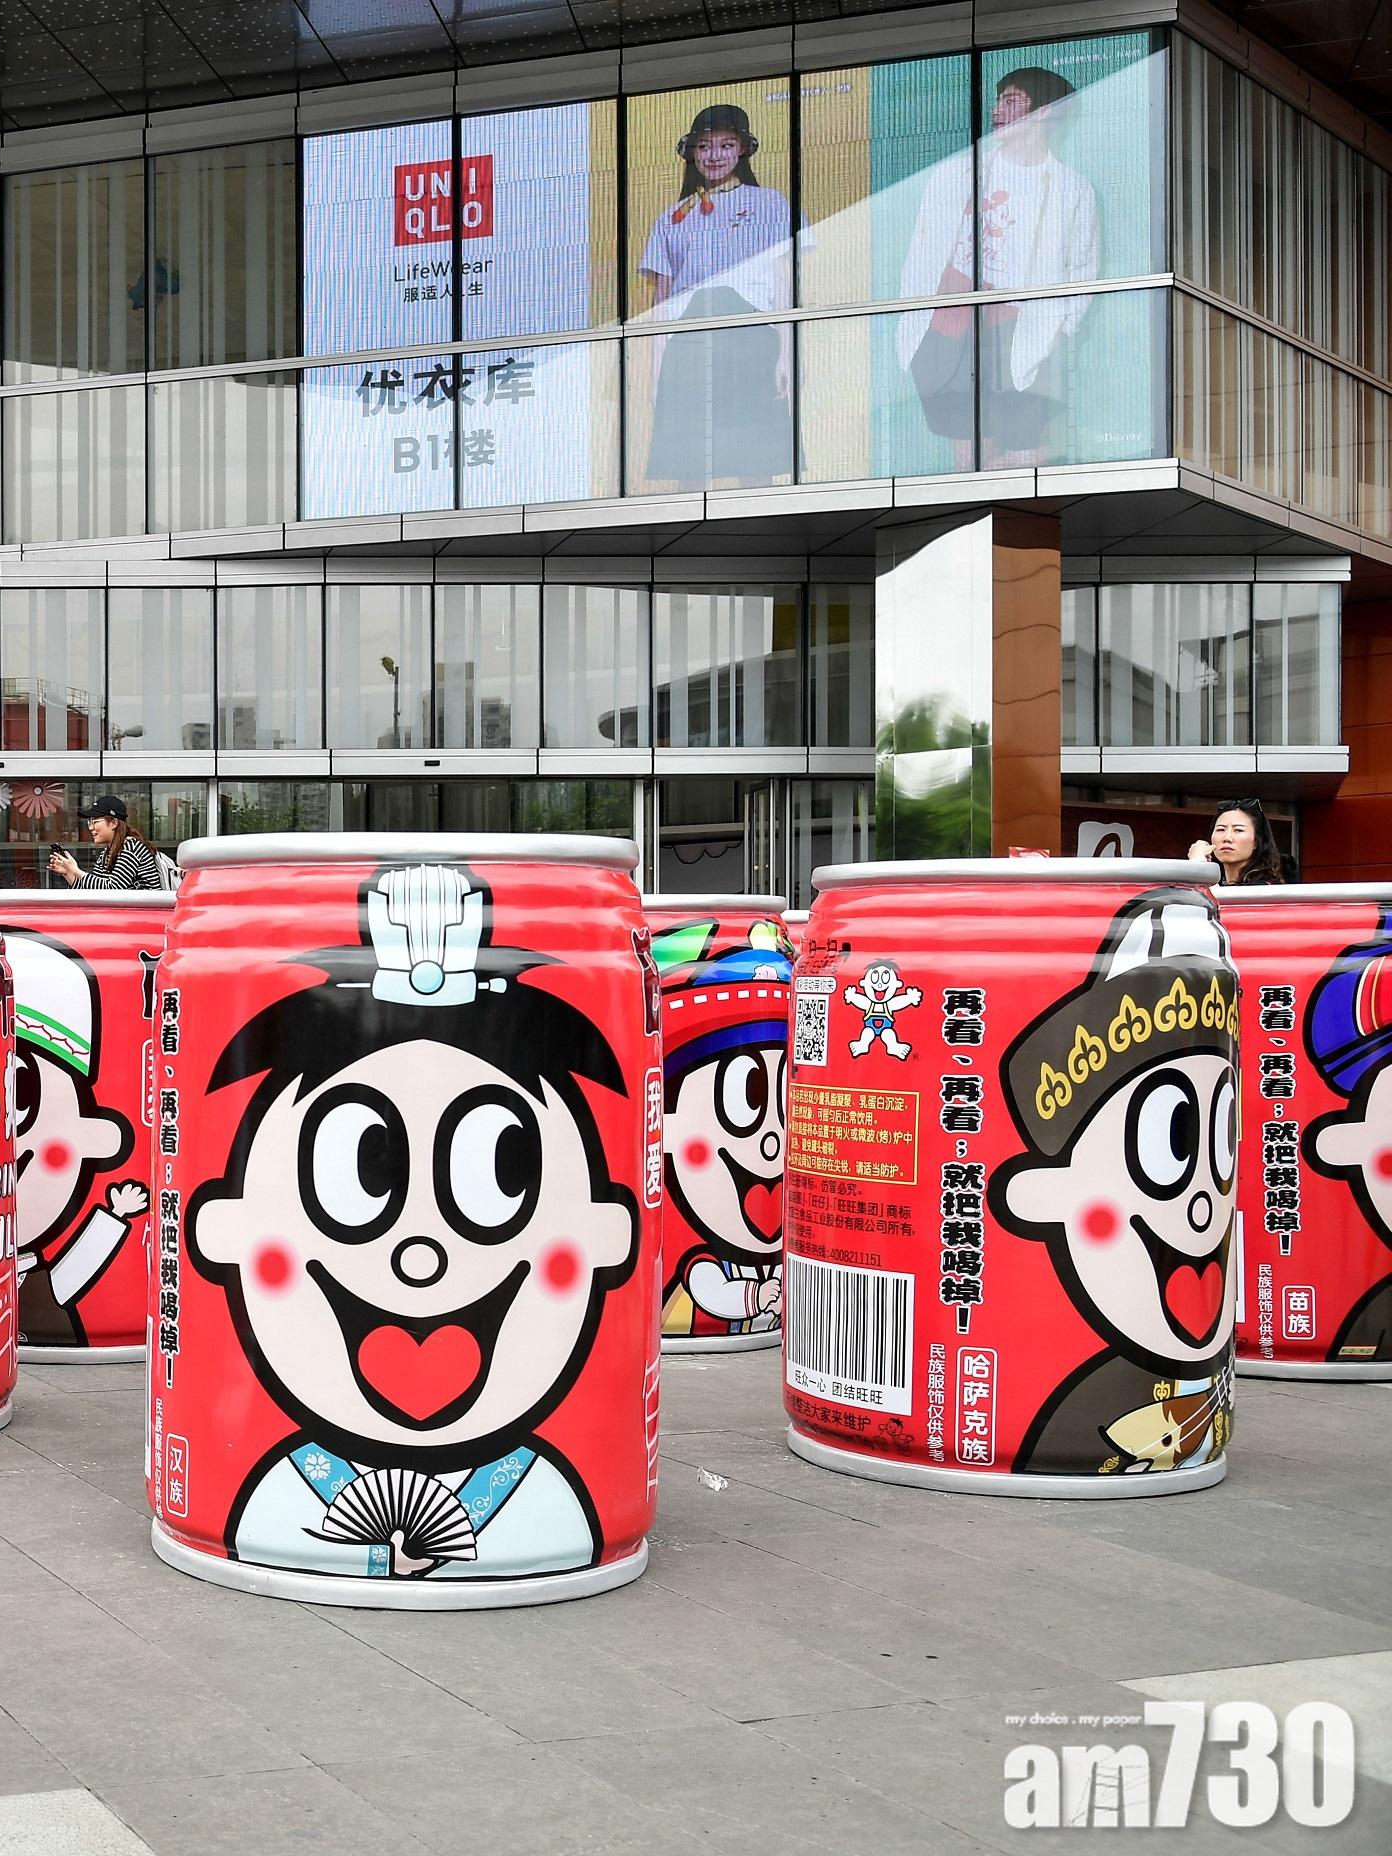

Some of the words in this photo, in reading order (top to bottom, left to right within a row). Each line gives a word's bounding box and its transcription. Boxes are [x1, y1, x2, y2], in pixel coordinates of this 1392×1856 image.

[405, 167, 477, 201] UNI
[405, 201, 482, 239] QLO
[394, 259, 493, 282] LifeWear
[357, 357, 536, 418] 优衣库
[393, 428, 496, 475] B1楼
[1288, 1292, 1310, 1333] 苗族
[832, 1381, 884, 1405] 团结旺旺
[927, 1343, 945, 1462] 民族服饰仅供参考
[962, 1354, 990, 1461] 哈萨克族
[170, 1446, 184, 1505] 汉族
